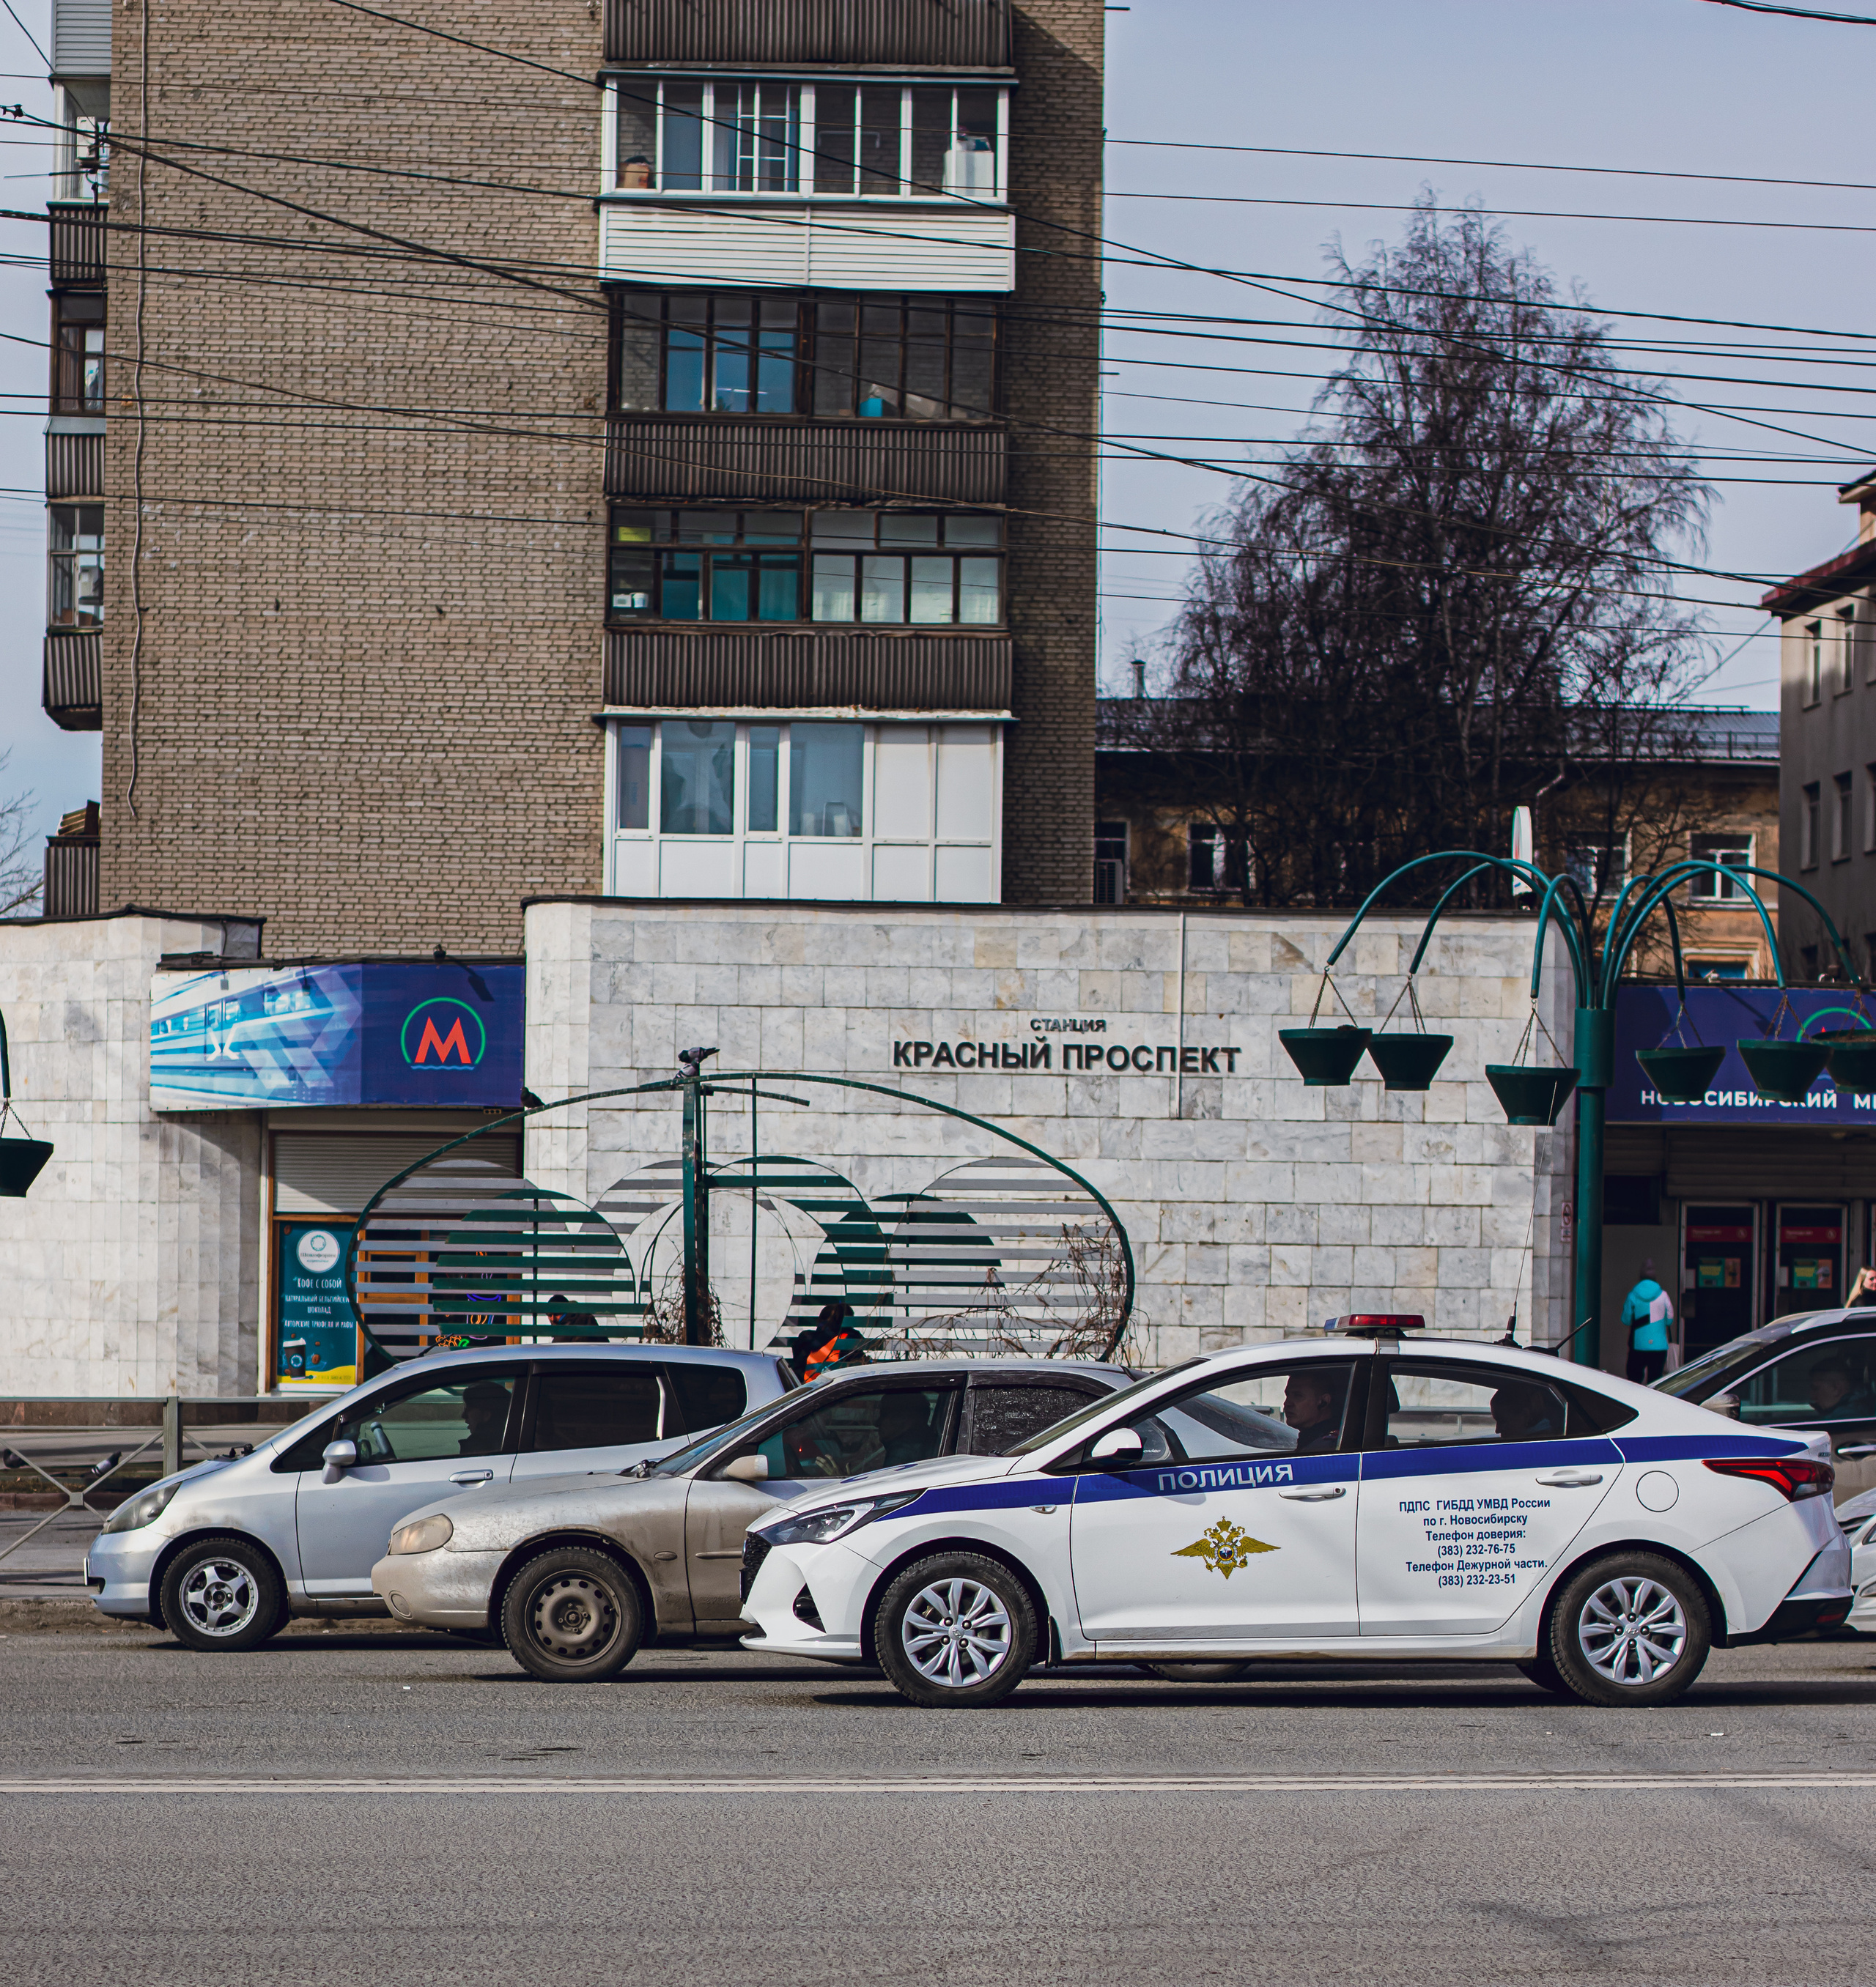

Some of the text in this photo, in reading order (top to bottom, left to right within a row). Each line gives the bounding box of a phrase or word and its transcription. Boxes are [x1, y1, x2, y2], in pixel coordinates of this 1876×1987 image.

[1030, 1018, 1107, 1033] СТАНЦИЯ
[415, 1016, 471, 1063] М
[893, 1035, 1241, 1073] КРАСНЫЙ ПРОСПЕКТ
[1641, 1089, 1876, 1109] НСИБИИЙ М
[298, 1278, 341, 1288] КОФЕ С СОБОЙ
[319, 1295, 350, 1303] БЕЛЬГИЙСКИ
[284, 1320, 310, 1328] АВТОРСКИЕ
[1158, 1464, 1293, 1491] ПОЛИЦИЯ
[1399, 1498, 1551, 1513] ПДПС ГИБДД УМВД России
[1423, 1514, 1528, 1526] по г. Новосибирску
[1425, 1530, 1526, 1542] Телефон доверия:
[1437, 1543, 1515, 1558] (383) 232-76-75
[1406, 1558, 1548, 1573] Телефон Дежурной части.
[1438, 1573, 1515, 1588] (383) 232-23-51
